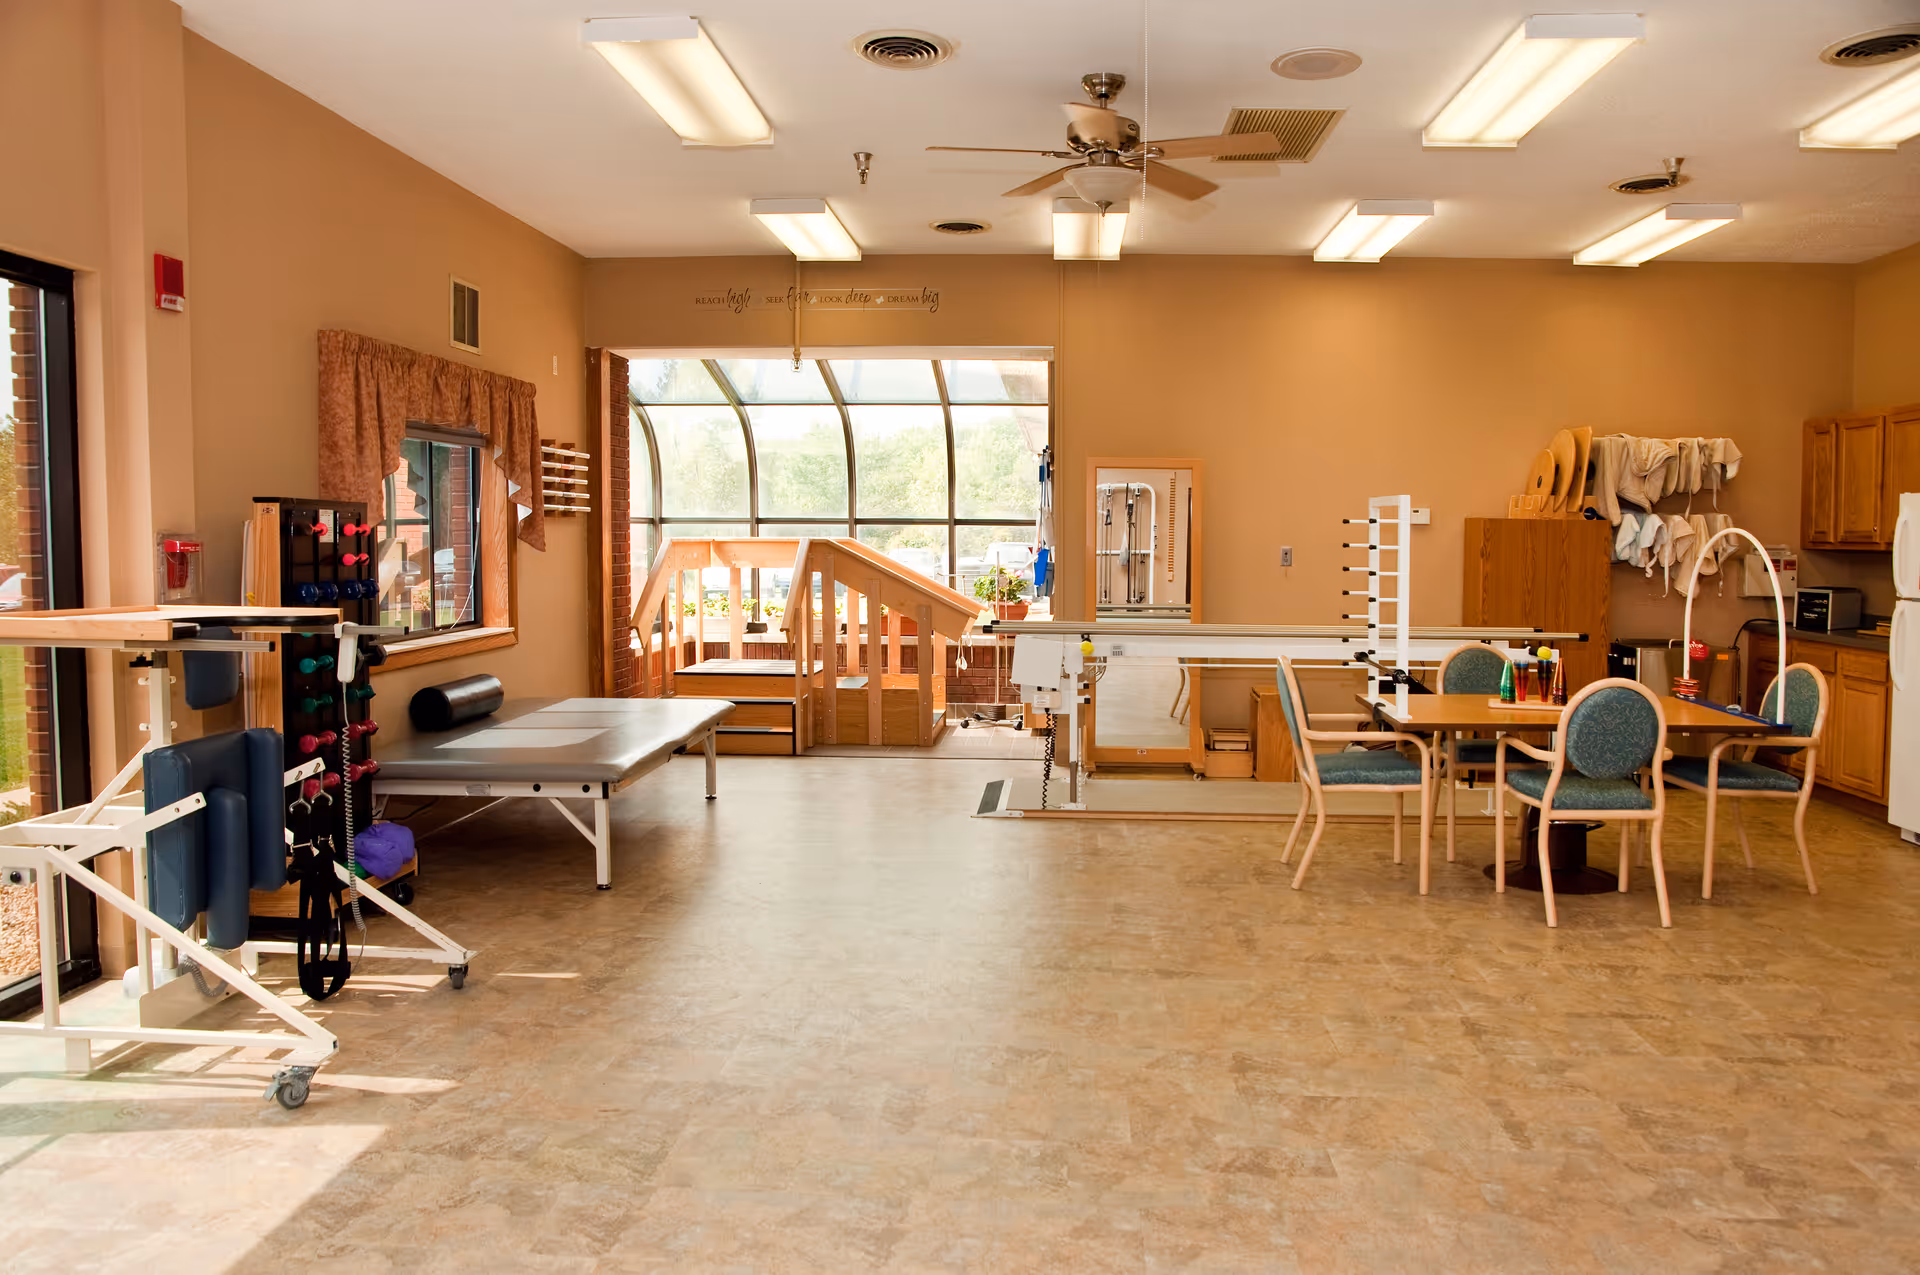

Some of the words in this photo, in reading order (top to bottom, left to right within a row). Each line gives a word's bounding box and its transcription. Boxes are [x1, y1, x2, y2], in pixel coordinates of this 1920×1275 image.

[163, 298, 178, 306] FIRE
[695, 296, 725, 305] REACH
[726, 287, 751, 314] high
[766, 296, 784, 304] SEEK
[820, 295, 843, 303] LOOK
[845, 288, 872, 313] deep
[887, 295, 919, 303] DREAM
[921, 286, 940, 313] big
